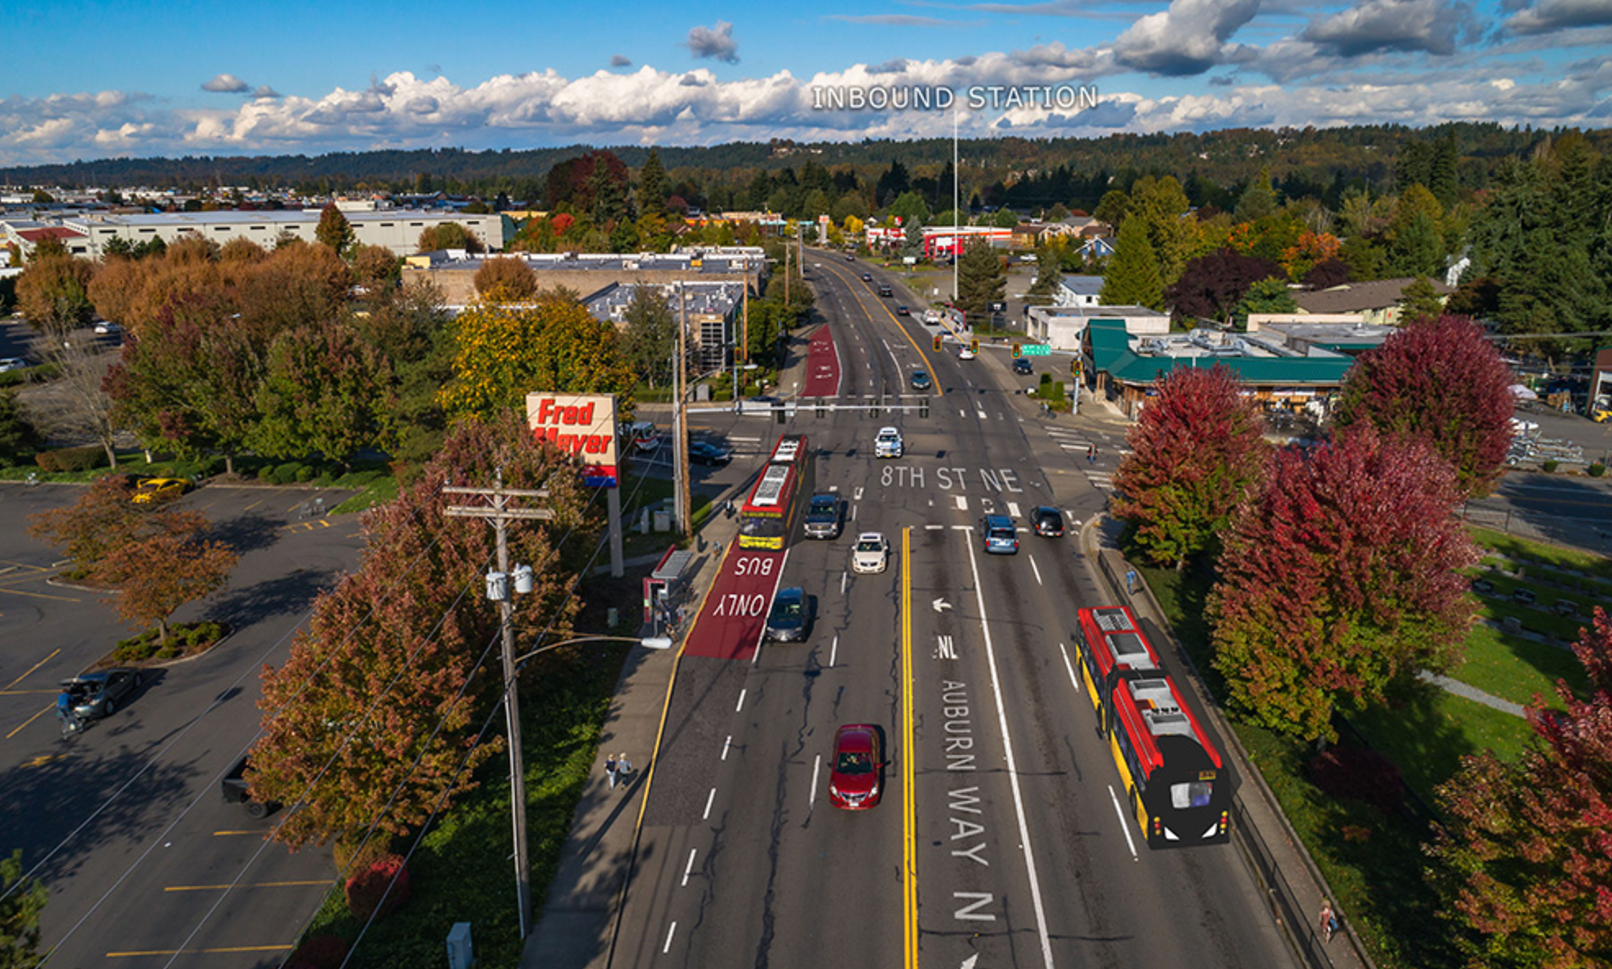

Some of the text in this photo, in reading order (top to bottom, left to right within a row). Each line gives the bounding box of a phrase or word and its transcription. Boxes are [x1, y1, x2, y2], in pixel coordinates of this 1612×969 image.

[538, 398, 595, 425] Fred
[734, 557, 774, 576] BUS
[713, 594, 765, 617] ONLY
